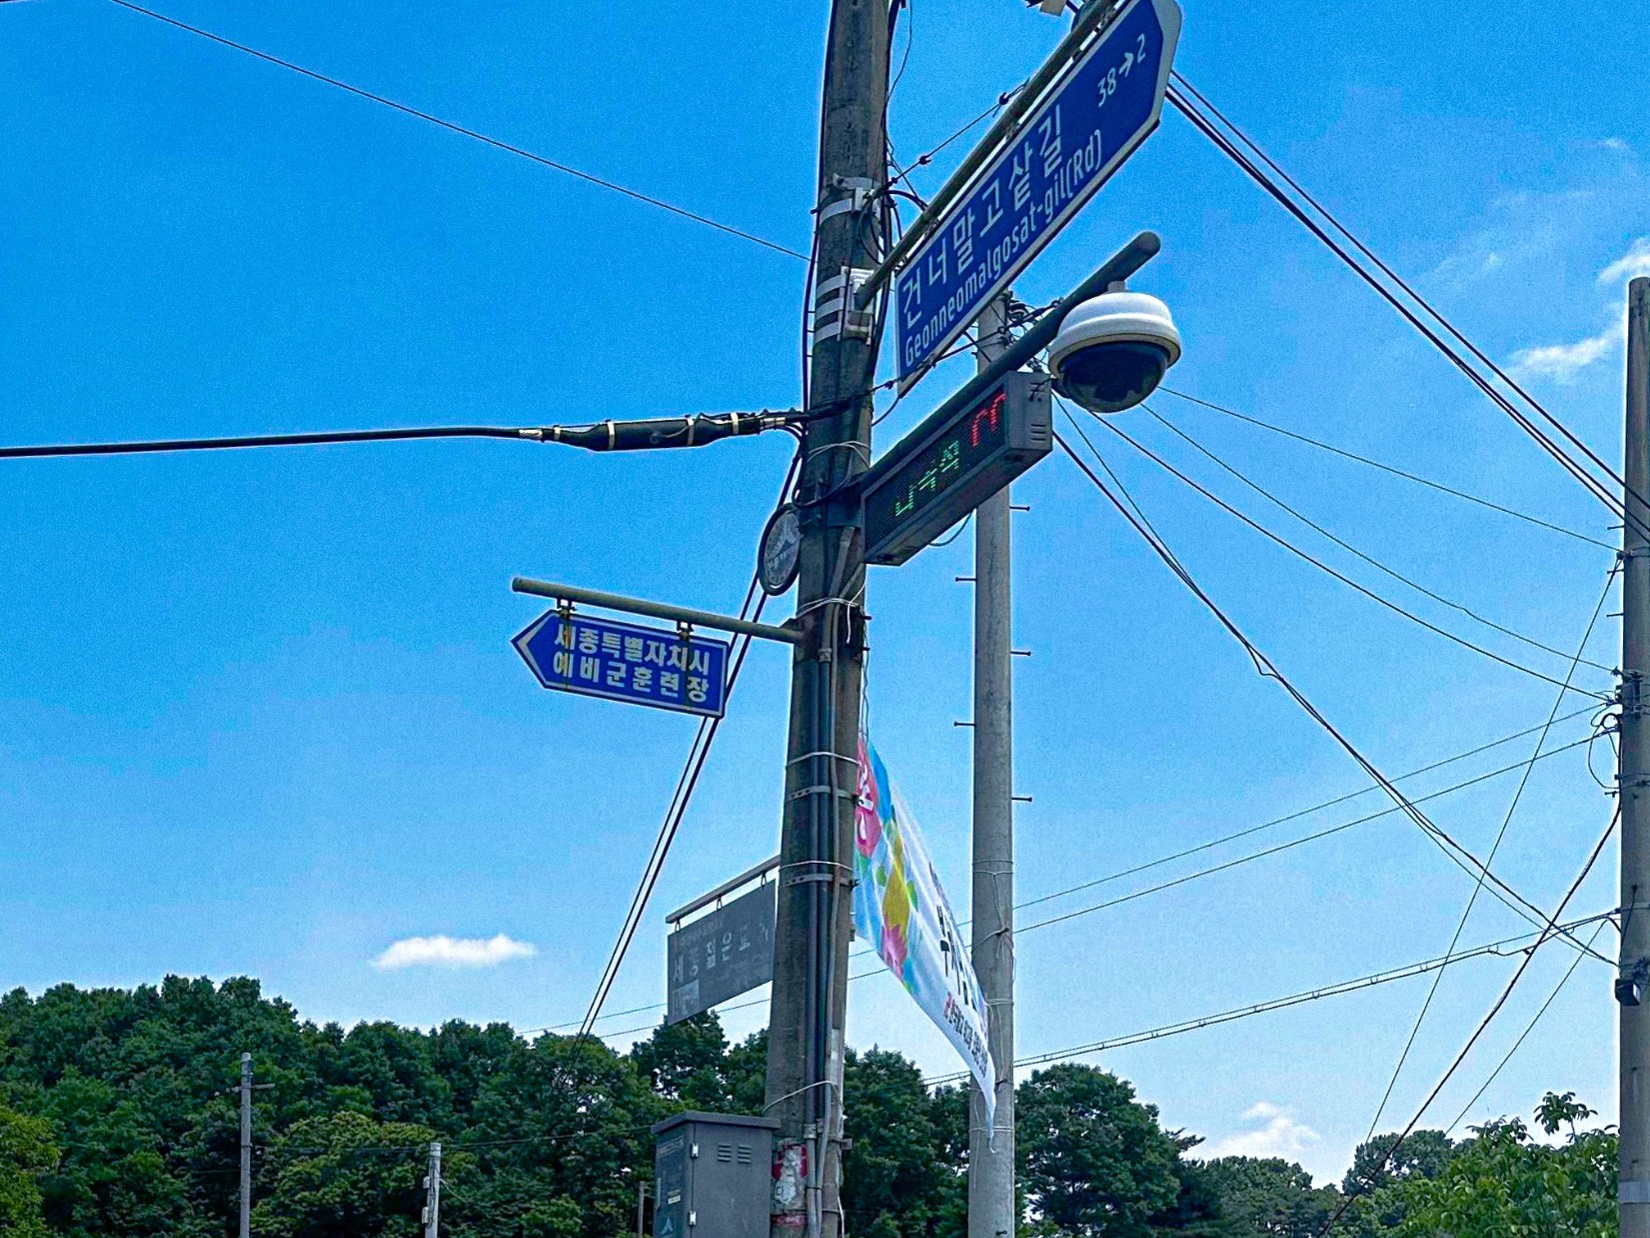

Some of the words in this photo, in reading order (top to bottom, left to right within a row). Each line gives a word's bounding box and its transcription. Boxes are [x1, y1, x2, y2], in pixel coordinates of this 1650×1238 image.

[1096, 69, 1117, 107] 38
[904, 129, 1103, 368] Geonneomalgosat-gil(Rd)
[554, 623, 710, 676] 세종특별자치시
[553, 651, 709, 702] 예비군훈련장
